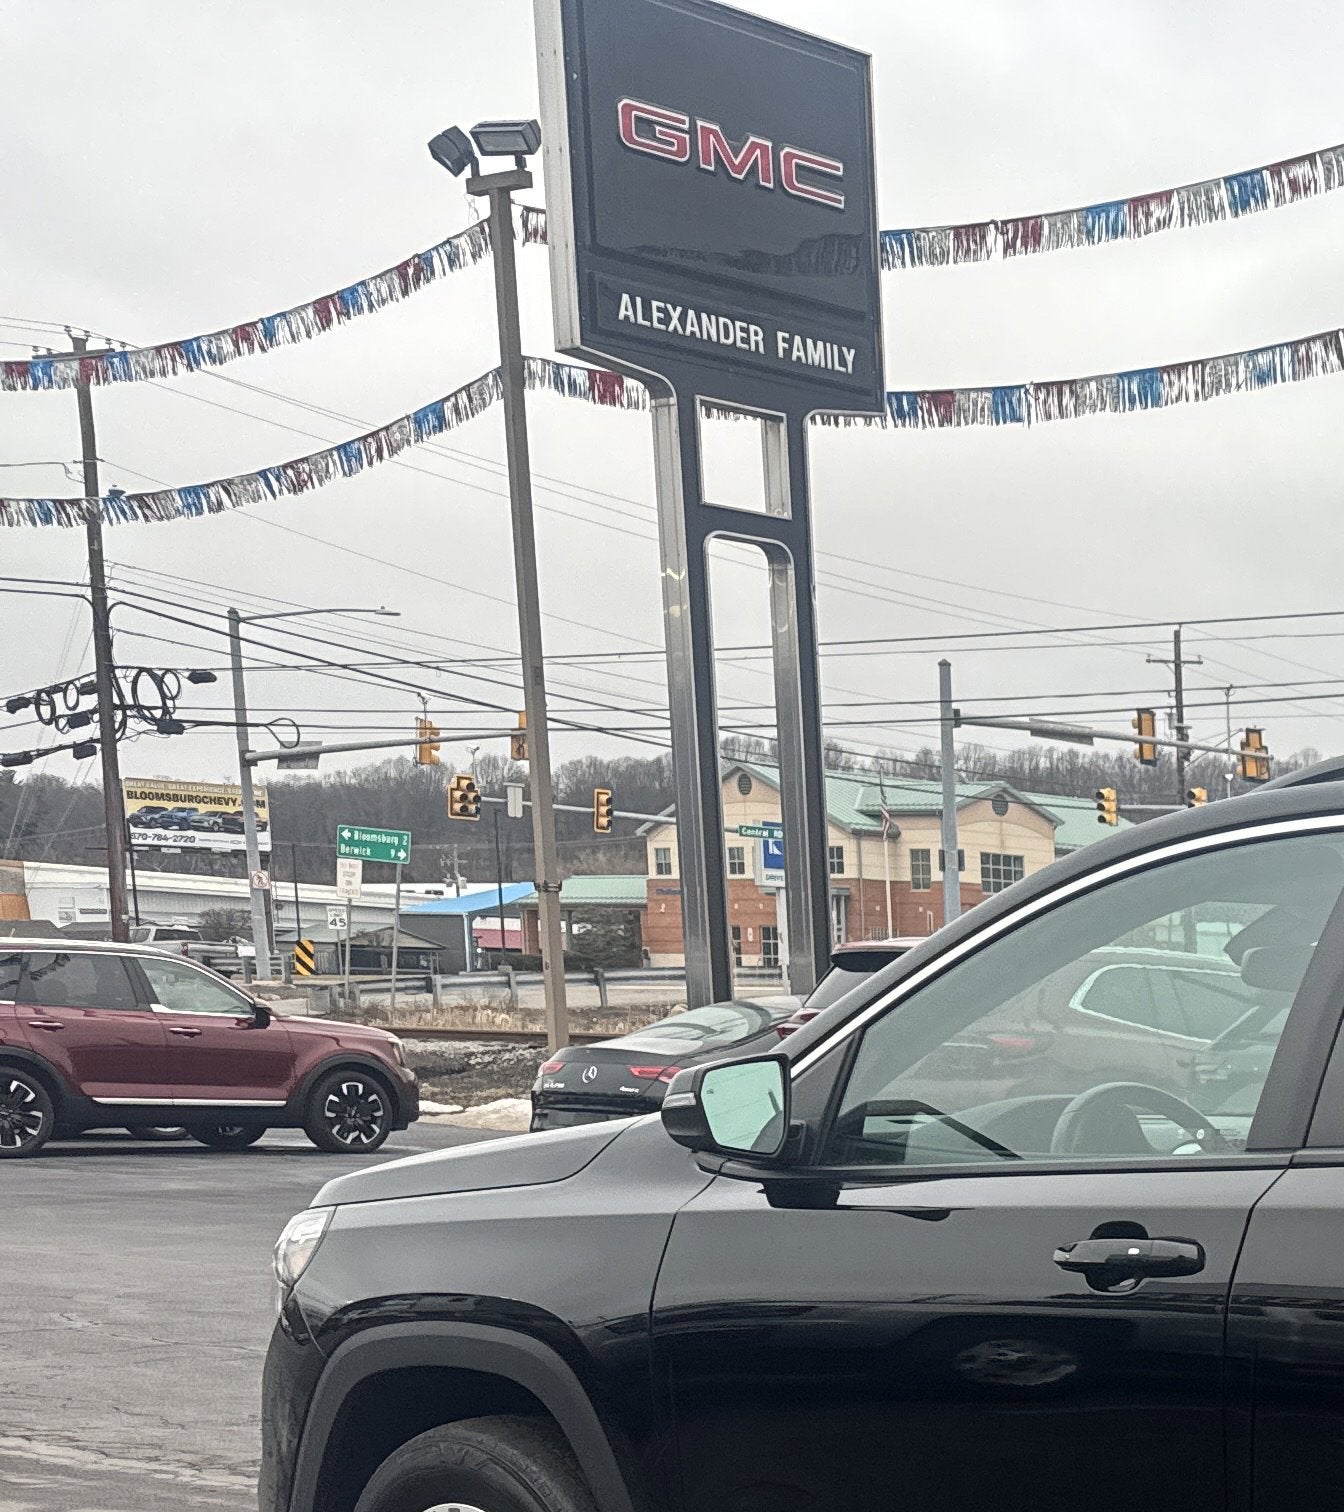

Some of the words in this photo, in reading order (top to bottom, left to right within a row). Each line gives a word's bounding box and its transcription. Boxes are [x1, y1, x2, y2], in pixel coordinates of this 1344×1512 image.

[616, 97, 845, 211] GMC
[617, 292, 765, 355] ALEXANDER
[776, 330, 857, 375] FAMILY
[353, 830, 399, 846] Bloomsburg
[402, 834, 408, 846] 2
[741, 827, 769, 837] Central
[340, 843, 371, 856] Berwick
[329, 918, 346, 927] 45
